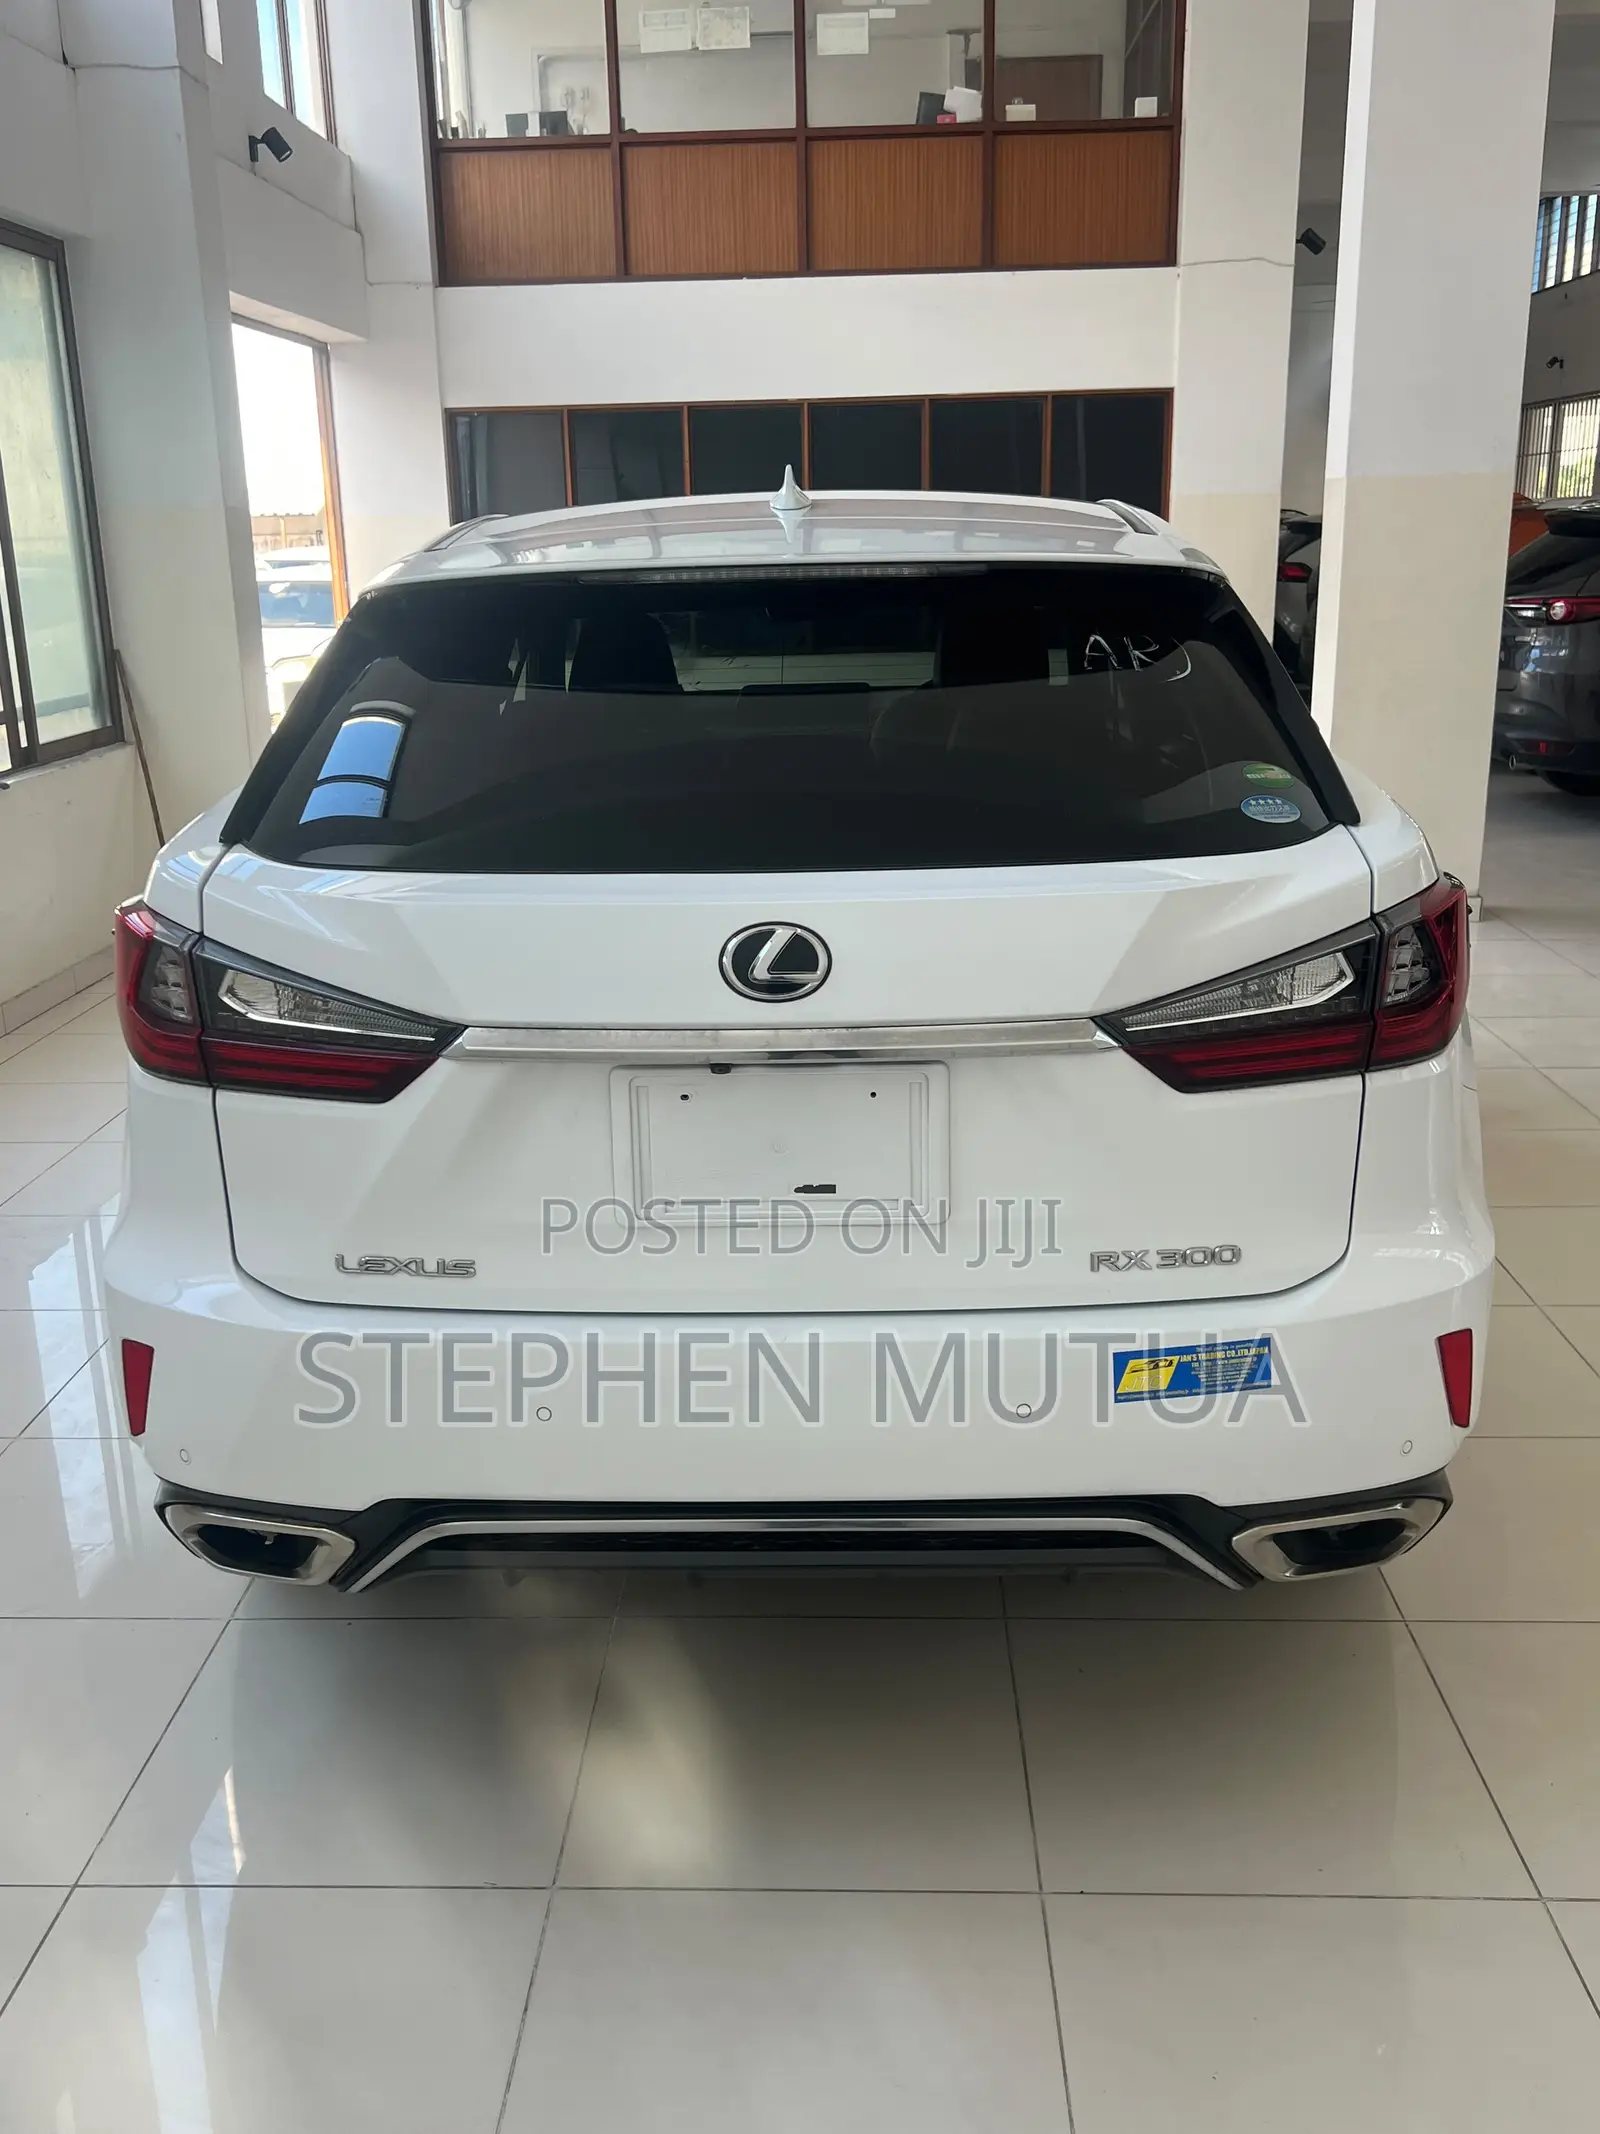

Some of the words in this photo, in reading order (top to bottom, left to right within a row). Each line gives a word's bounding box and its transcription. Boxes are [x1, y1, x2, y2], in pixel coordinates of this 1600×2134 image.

[334, 1253, 477, 1279] LEXUS
[1090, 1248, 1153, 1273] RX
[1156, 1244, 1242, 1269] 300
